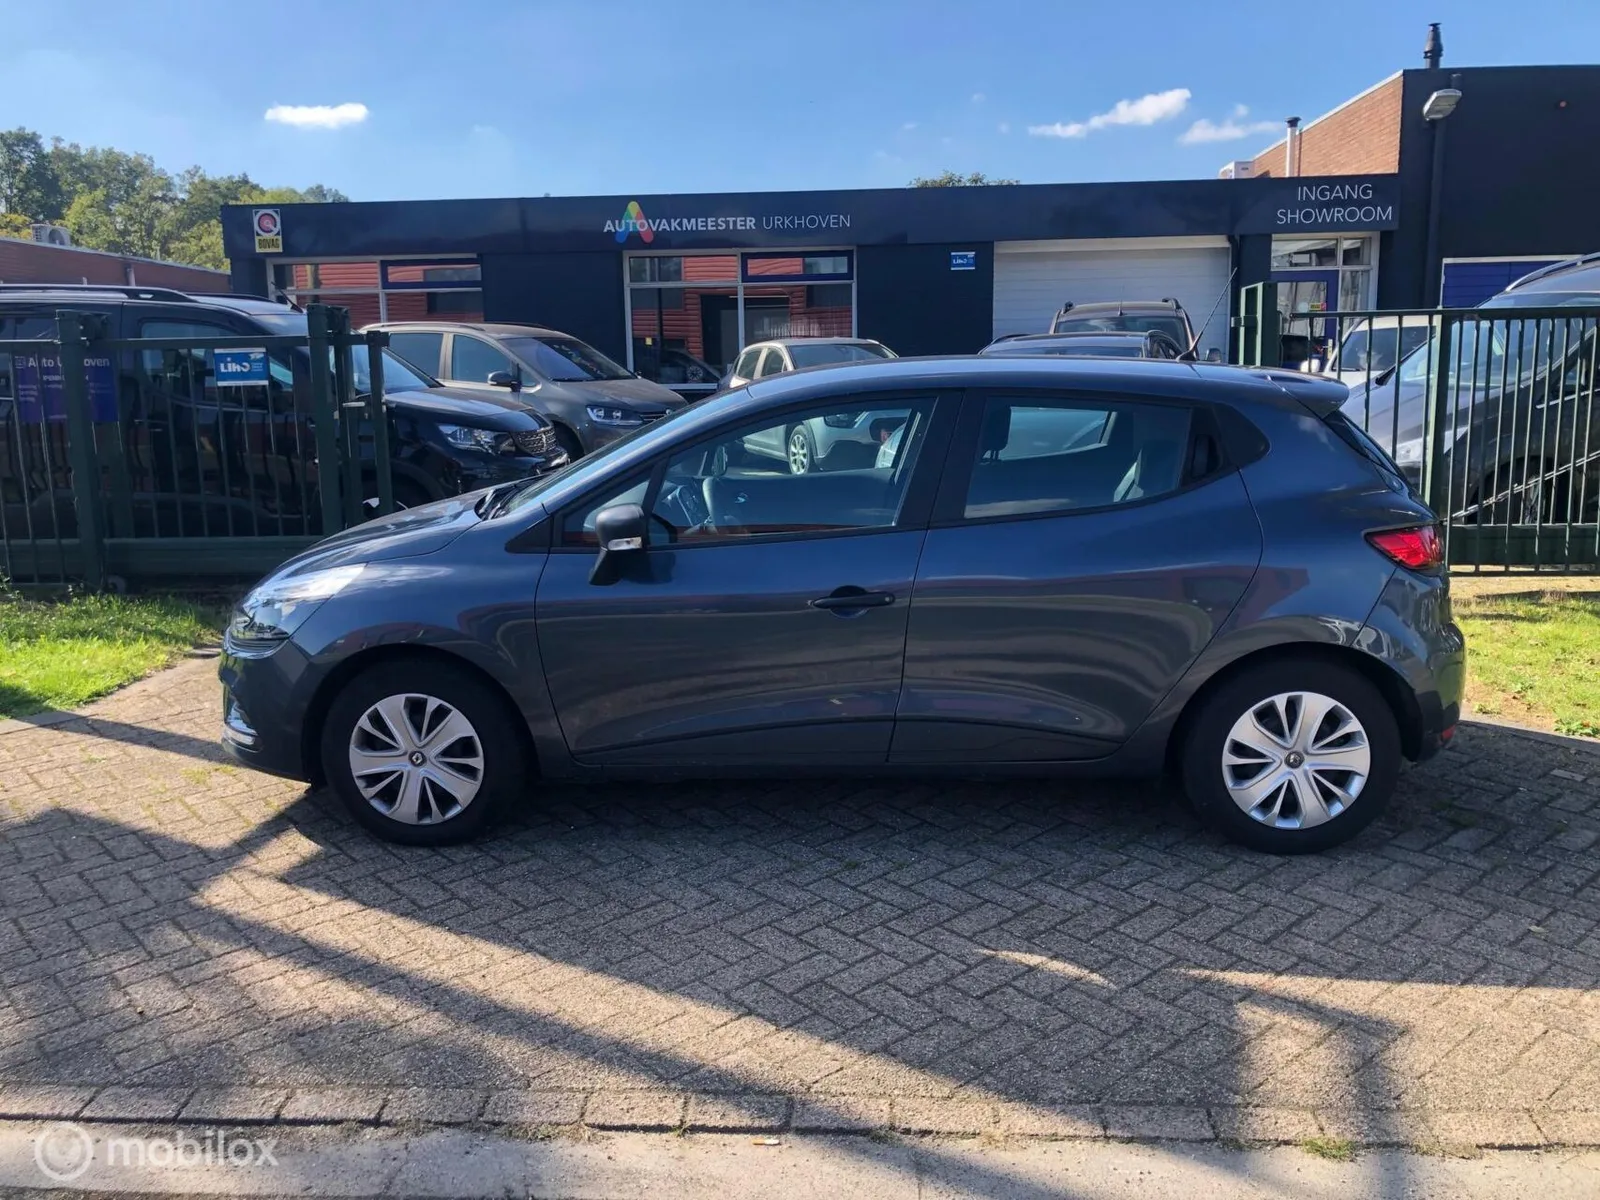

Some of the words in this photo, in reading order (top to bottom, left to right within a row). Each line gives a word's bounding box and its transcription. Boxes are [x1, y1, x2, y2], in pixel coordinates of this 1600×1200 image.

[1297, 184, 1373, 201] INGANG
[603, 217, 756, 234] AUTOVAKMEESTER
[762, 214, 851, 231] URKHOVEN
[1276, 205, 1393, 225] SHOWROOM
